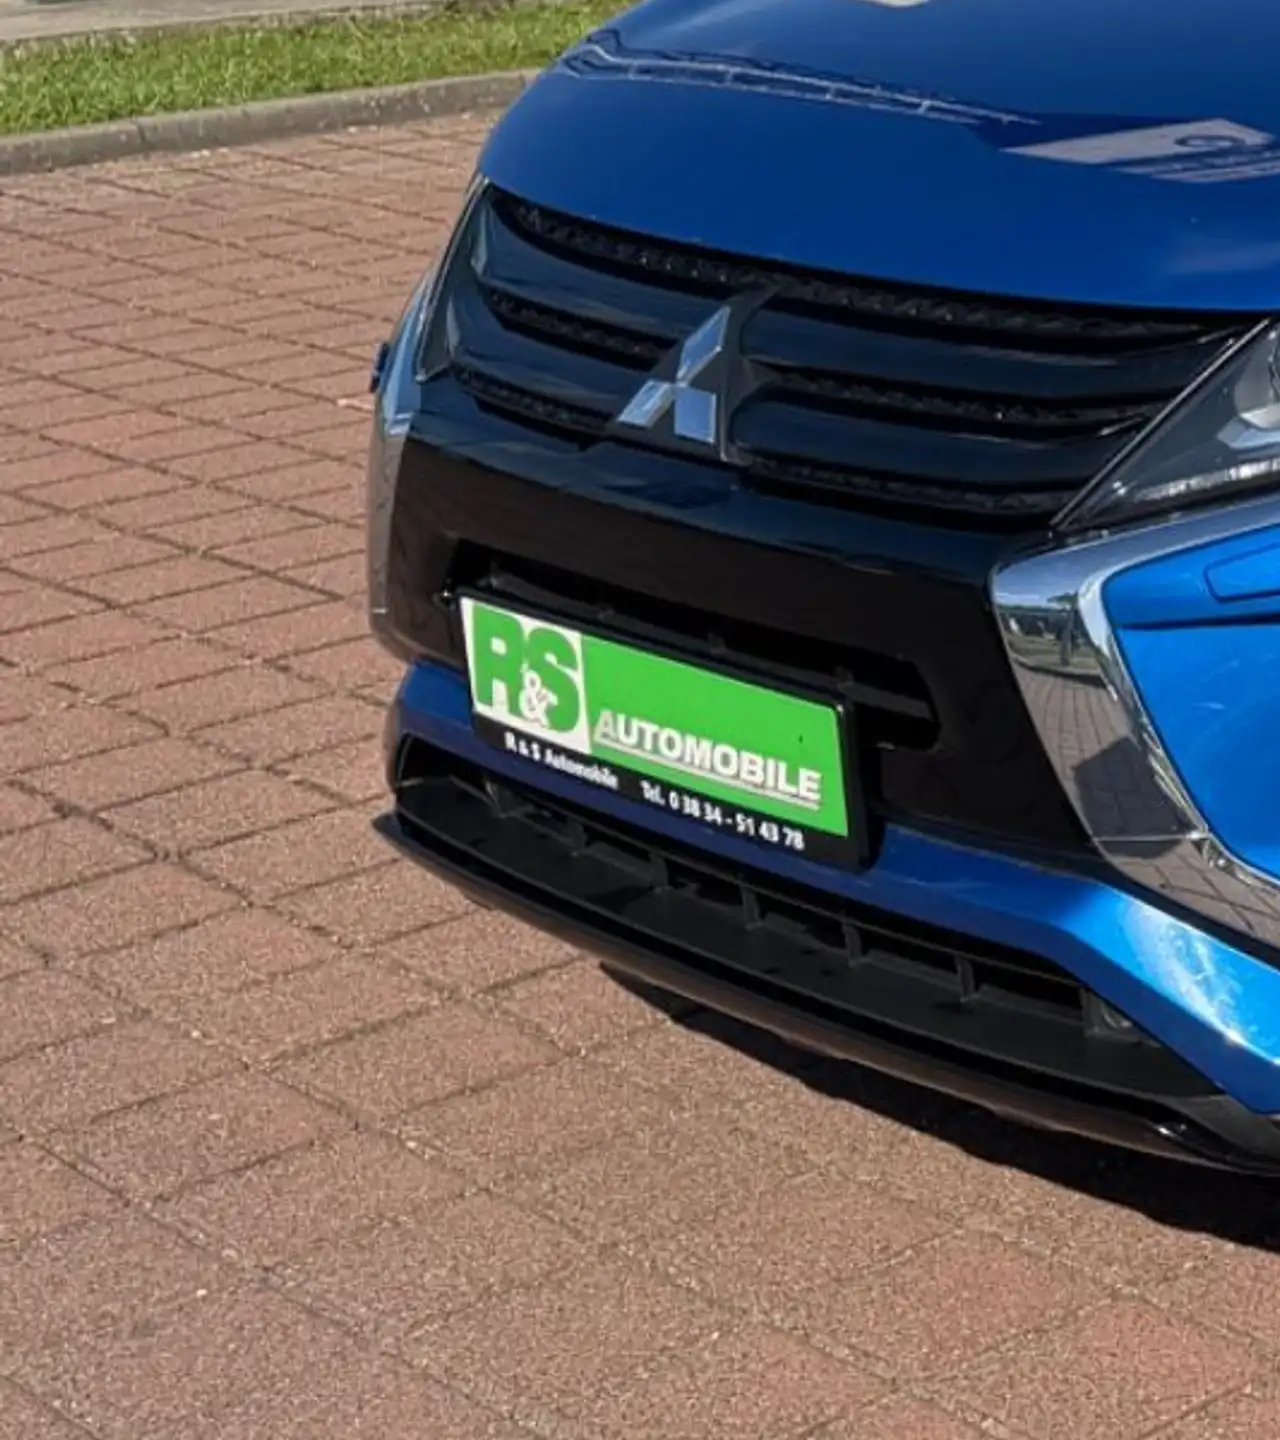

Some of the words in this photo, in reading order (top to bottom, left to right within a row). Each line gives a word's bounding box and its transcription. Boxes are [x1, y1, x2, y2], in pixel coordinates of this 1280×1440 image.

[473, 603, 581, 734] R&S
[594, 710, 822, 801] AUTOMOBILE
[544, 748, 619, 791] Automobile
[639, 780, 665, 806] Tel.
